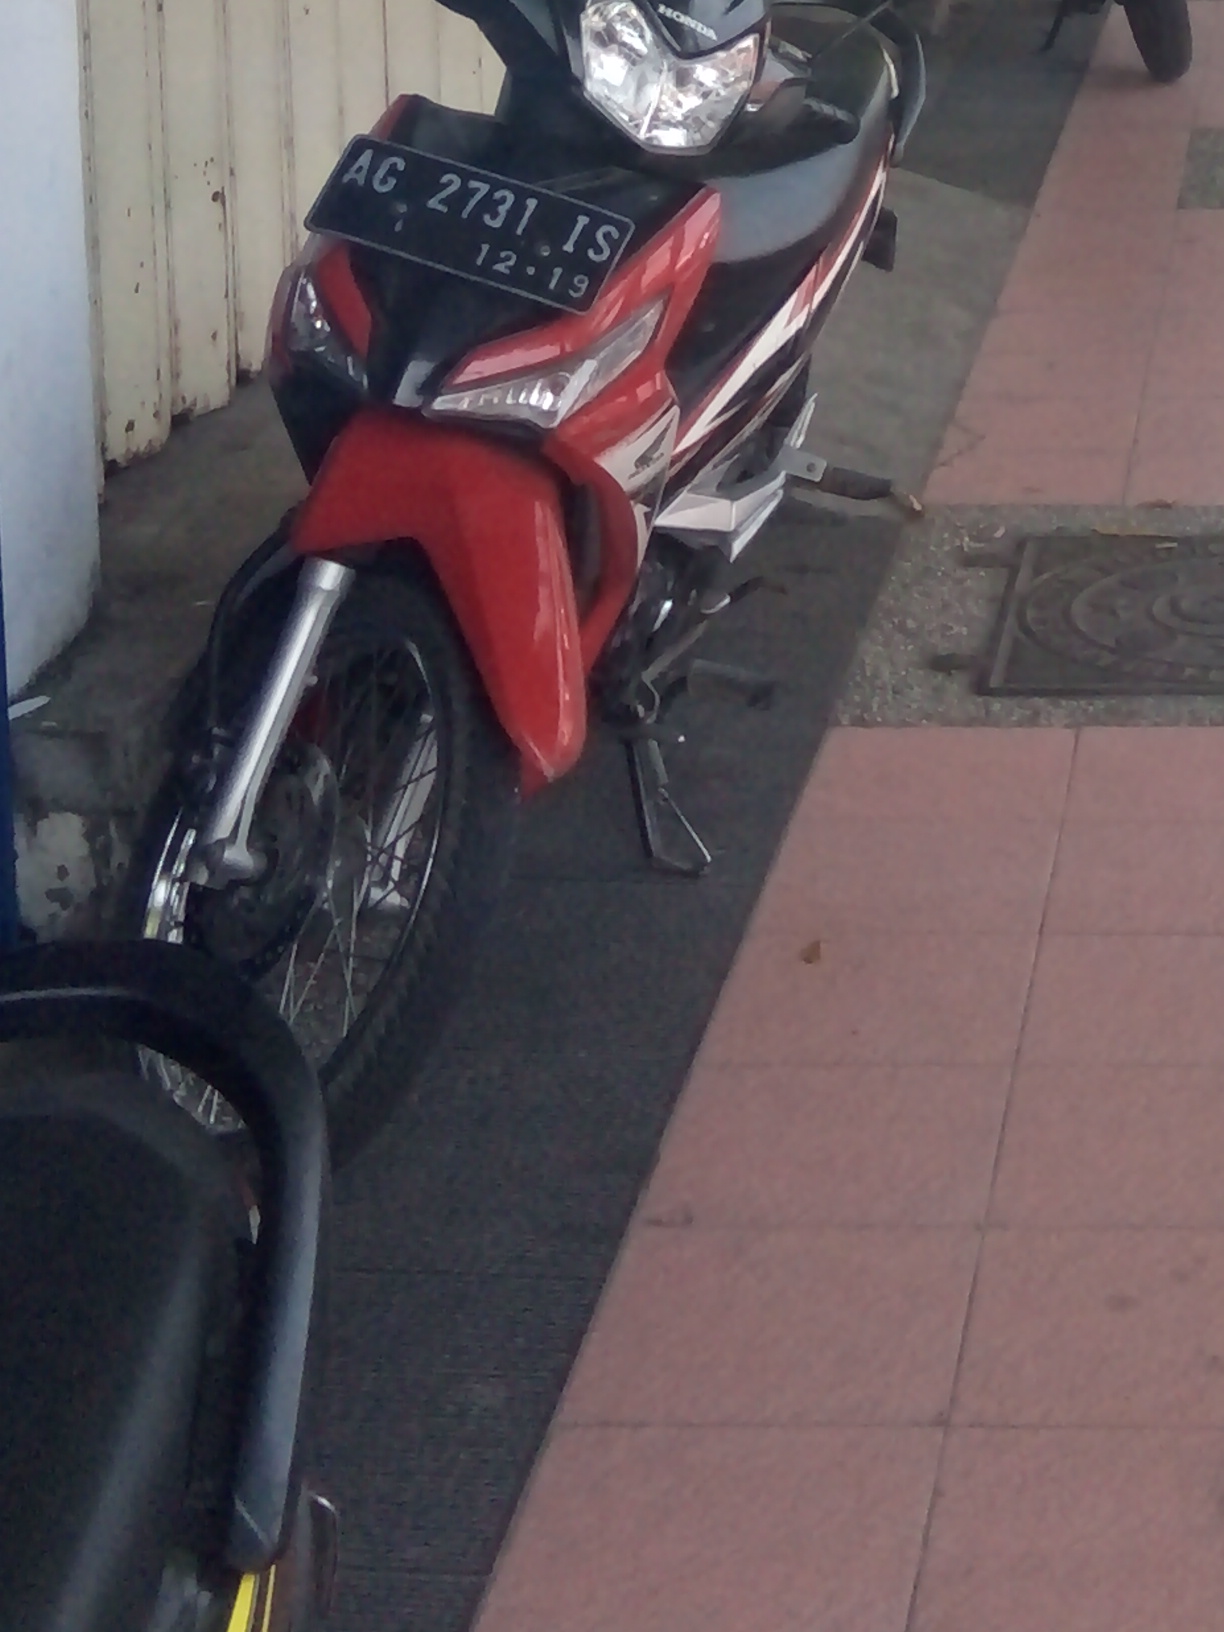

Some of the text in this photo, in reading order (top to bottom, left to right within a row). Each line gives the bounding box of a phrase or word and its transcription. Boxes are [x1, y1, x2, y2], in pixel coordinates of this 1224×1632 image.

[658, 3, 718, 41] HONDA
[343, 148, 619, 263] AG 2731 IS
